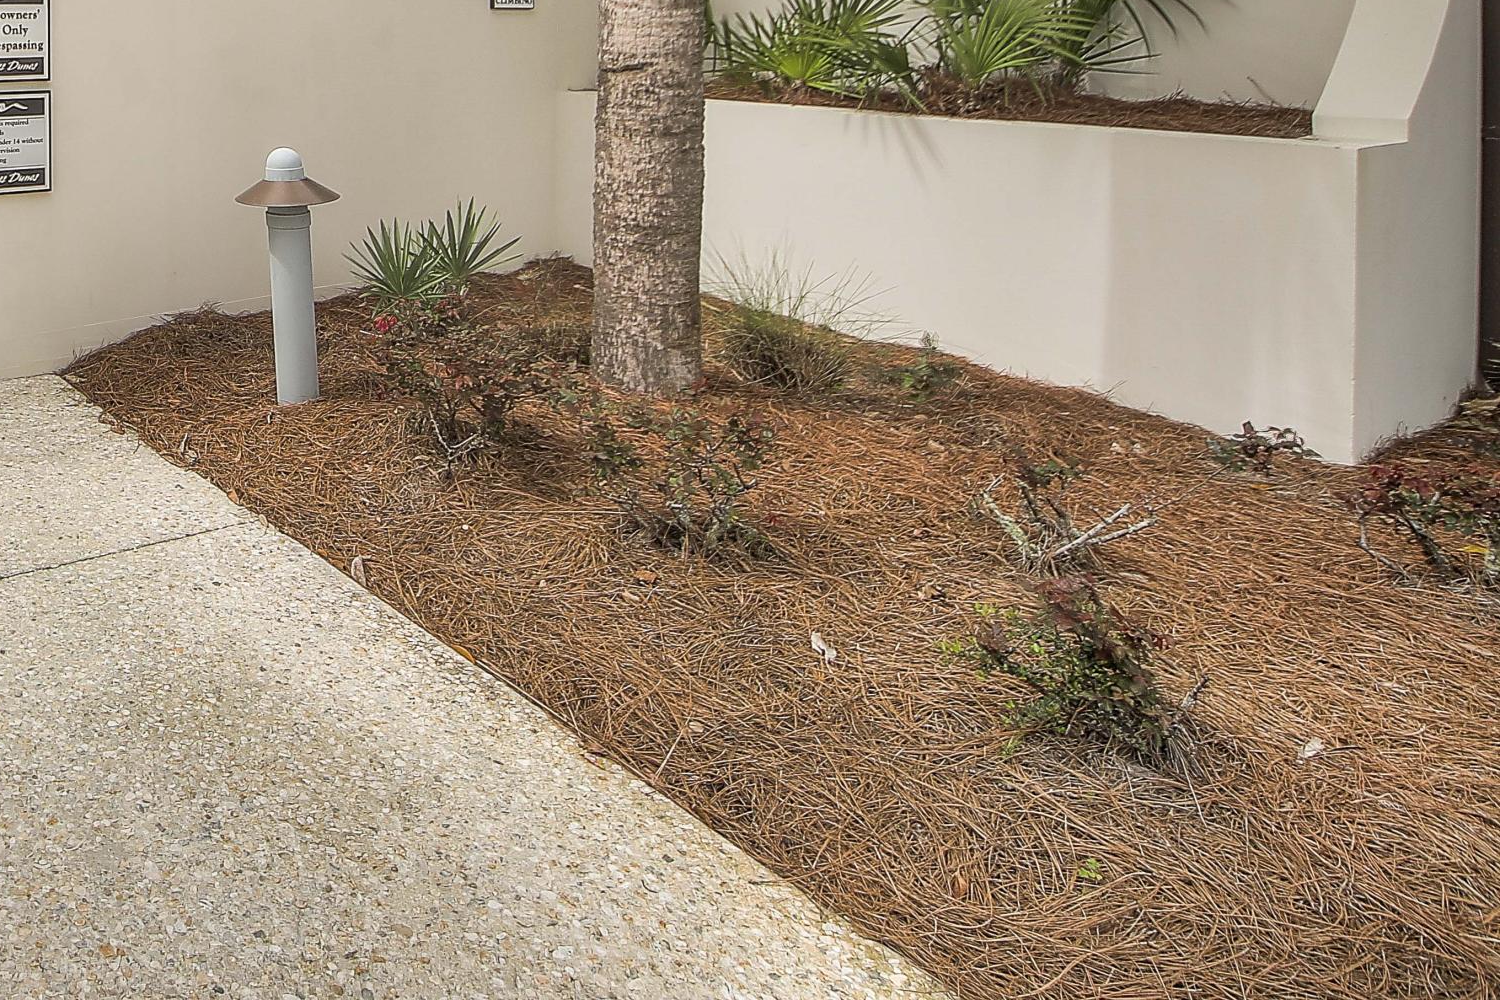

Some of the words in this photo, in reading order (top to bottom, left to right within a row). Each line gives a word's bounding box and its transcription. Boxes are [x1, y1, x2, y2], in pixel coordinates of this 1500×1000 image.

[2, 24, 28, 37] Only
[6, 60, 38, 71] Dunes
[5, 118, 29, 126] required
[8, 172, 40, 183] Dunes
